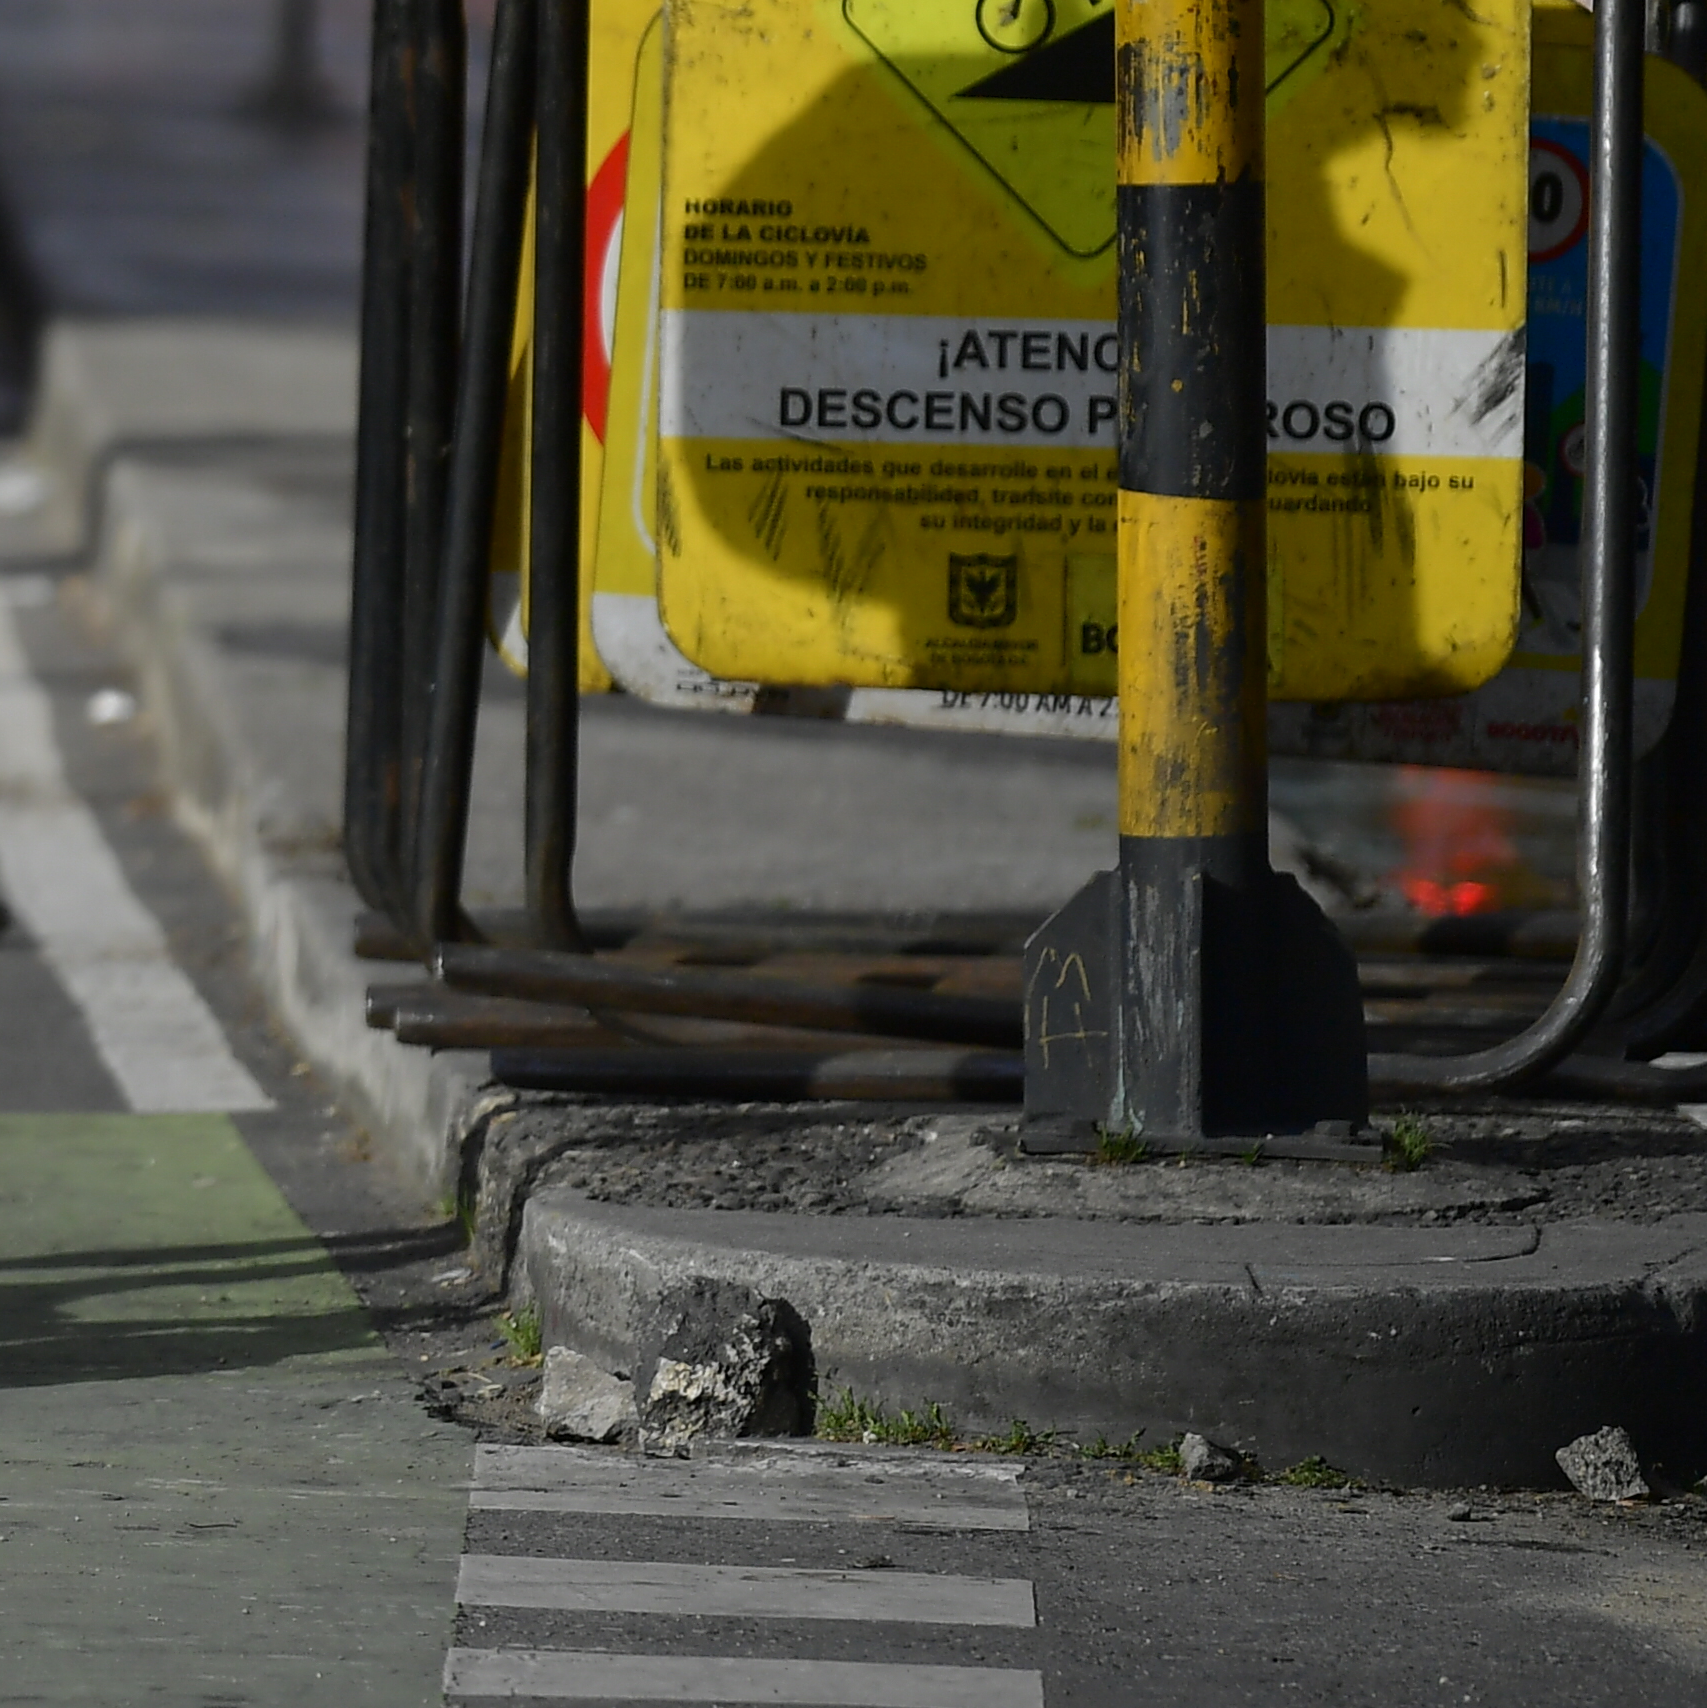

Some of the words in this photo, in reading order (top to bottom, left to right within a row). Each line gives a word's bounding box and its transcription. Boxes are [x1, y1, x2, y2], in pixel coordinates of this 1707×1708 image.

[685, 197, 793, 216] HORARIO
[1532, 172, 1564, 225] 0
[684, 223, 714, 241] DE
[723, 223, 752, 241] LA
[684, 248, 799, 268] DOMINGOS
[805, 250, 818, 269] Y
[824, 251, 928, 271] FESTIVOS
[684, 272, 710, 289] DE
[718, 273, 757, 290] 7:00
[809, 280, 820, 292] a
[826, 276, 867, 293] 2:00
[938, 328, 1119, 378] ¡ATENC
[780, 386, 1071, 434] DESCENSO
[705, 453, 743, 472] Las
[752, 453, 874, 476] actividades
[886, 460, 921, 479] que
[929, 459, 1039, 480] desarrolle
[1046, 464, 1072, 480] en
[1080, 462, 1099, 480] el
[1394, 470, 1440, 493] bajo
[1449, 475, 1475, 490] su
[1269, 494, 1372, 513] uardando
[920, 515, 946, 531] su
[952, 513, 1062, 536] integridad
[1068, 517, 1082, 537] y
[1088, 515, 1106, 532] la
